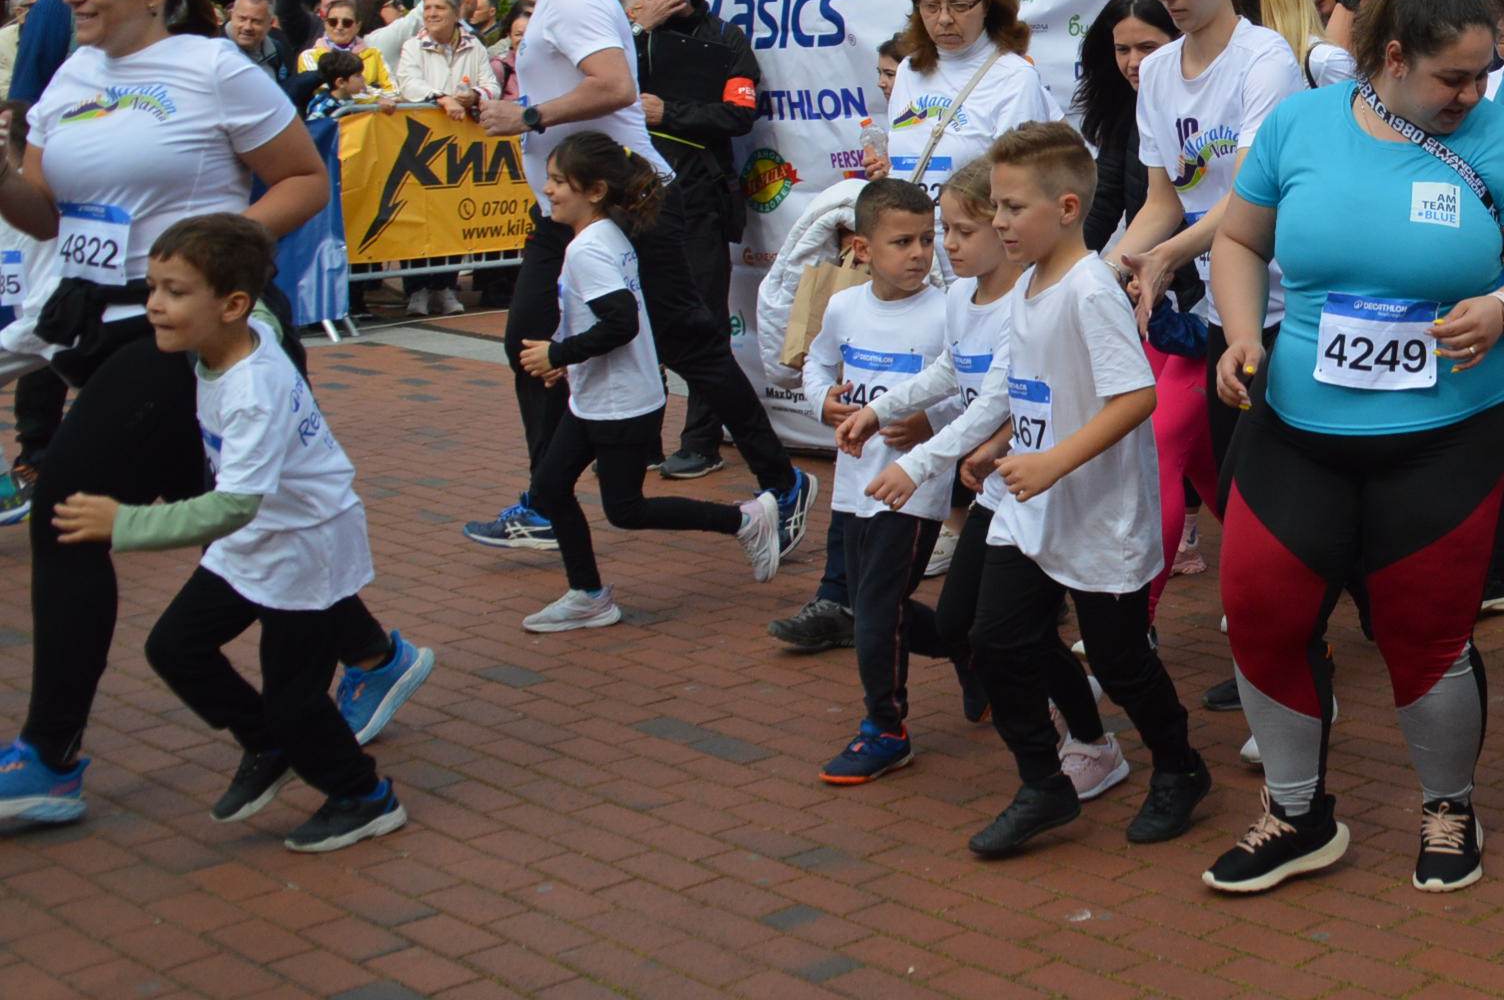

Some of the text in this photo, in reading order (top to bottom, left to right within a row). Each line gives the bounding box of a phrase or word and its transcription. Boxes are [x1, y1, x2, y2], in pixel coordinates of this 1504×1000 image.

[756, 87, 869, 121] ATHLON
[358, 115, 526, 255] КИЛ
[482, 199, 518, 217] 0700
[1422, 200, 1457, 213] TEAM
[1437, 193, 1457, 204] AM
[1425, 211, 1457, 224] BLUE
[462, 218, 535, 240] www.kila
[60, 234, 118, 269] 4822
[1363, 301, 1408, 312] DECATHLON
[1324, 333, 1427, 373] 4249
[766, 387, 806, 403] MaxDyn
[1012, 414, 1046, 450] 467
